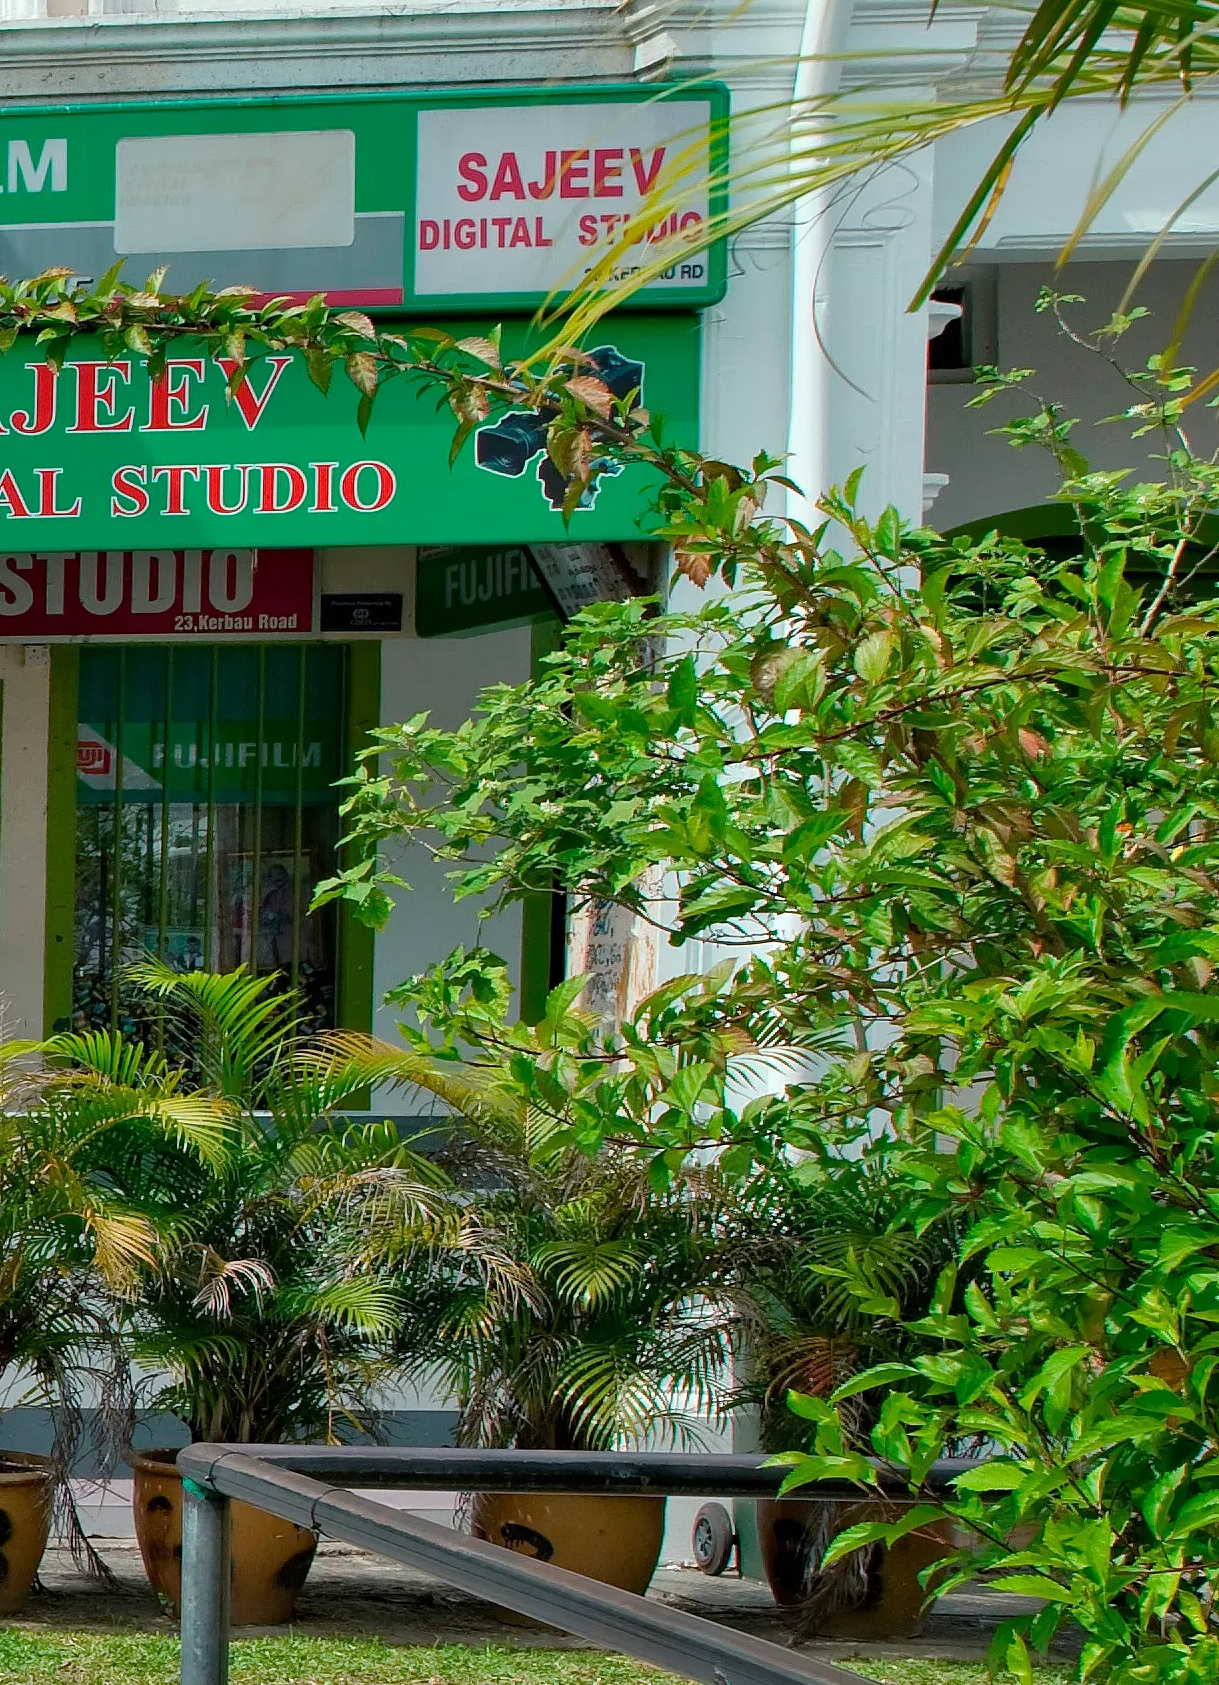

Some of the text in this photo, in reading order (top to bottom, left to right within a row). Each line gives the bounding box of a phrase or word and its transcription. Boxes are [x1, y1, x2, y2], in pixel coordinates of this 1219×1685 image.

[457, 147, 666, 202] SAJEEV
[420, 216, 553, 250] DIGITAL
[681, 264, 704, 280] RD
[110, 460, 397, 518] STUDIO
[444, 548, 542, 609] FUJIFI
[174, 614, 298, 633] 23,Kerbau Road
